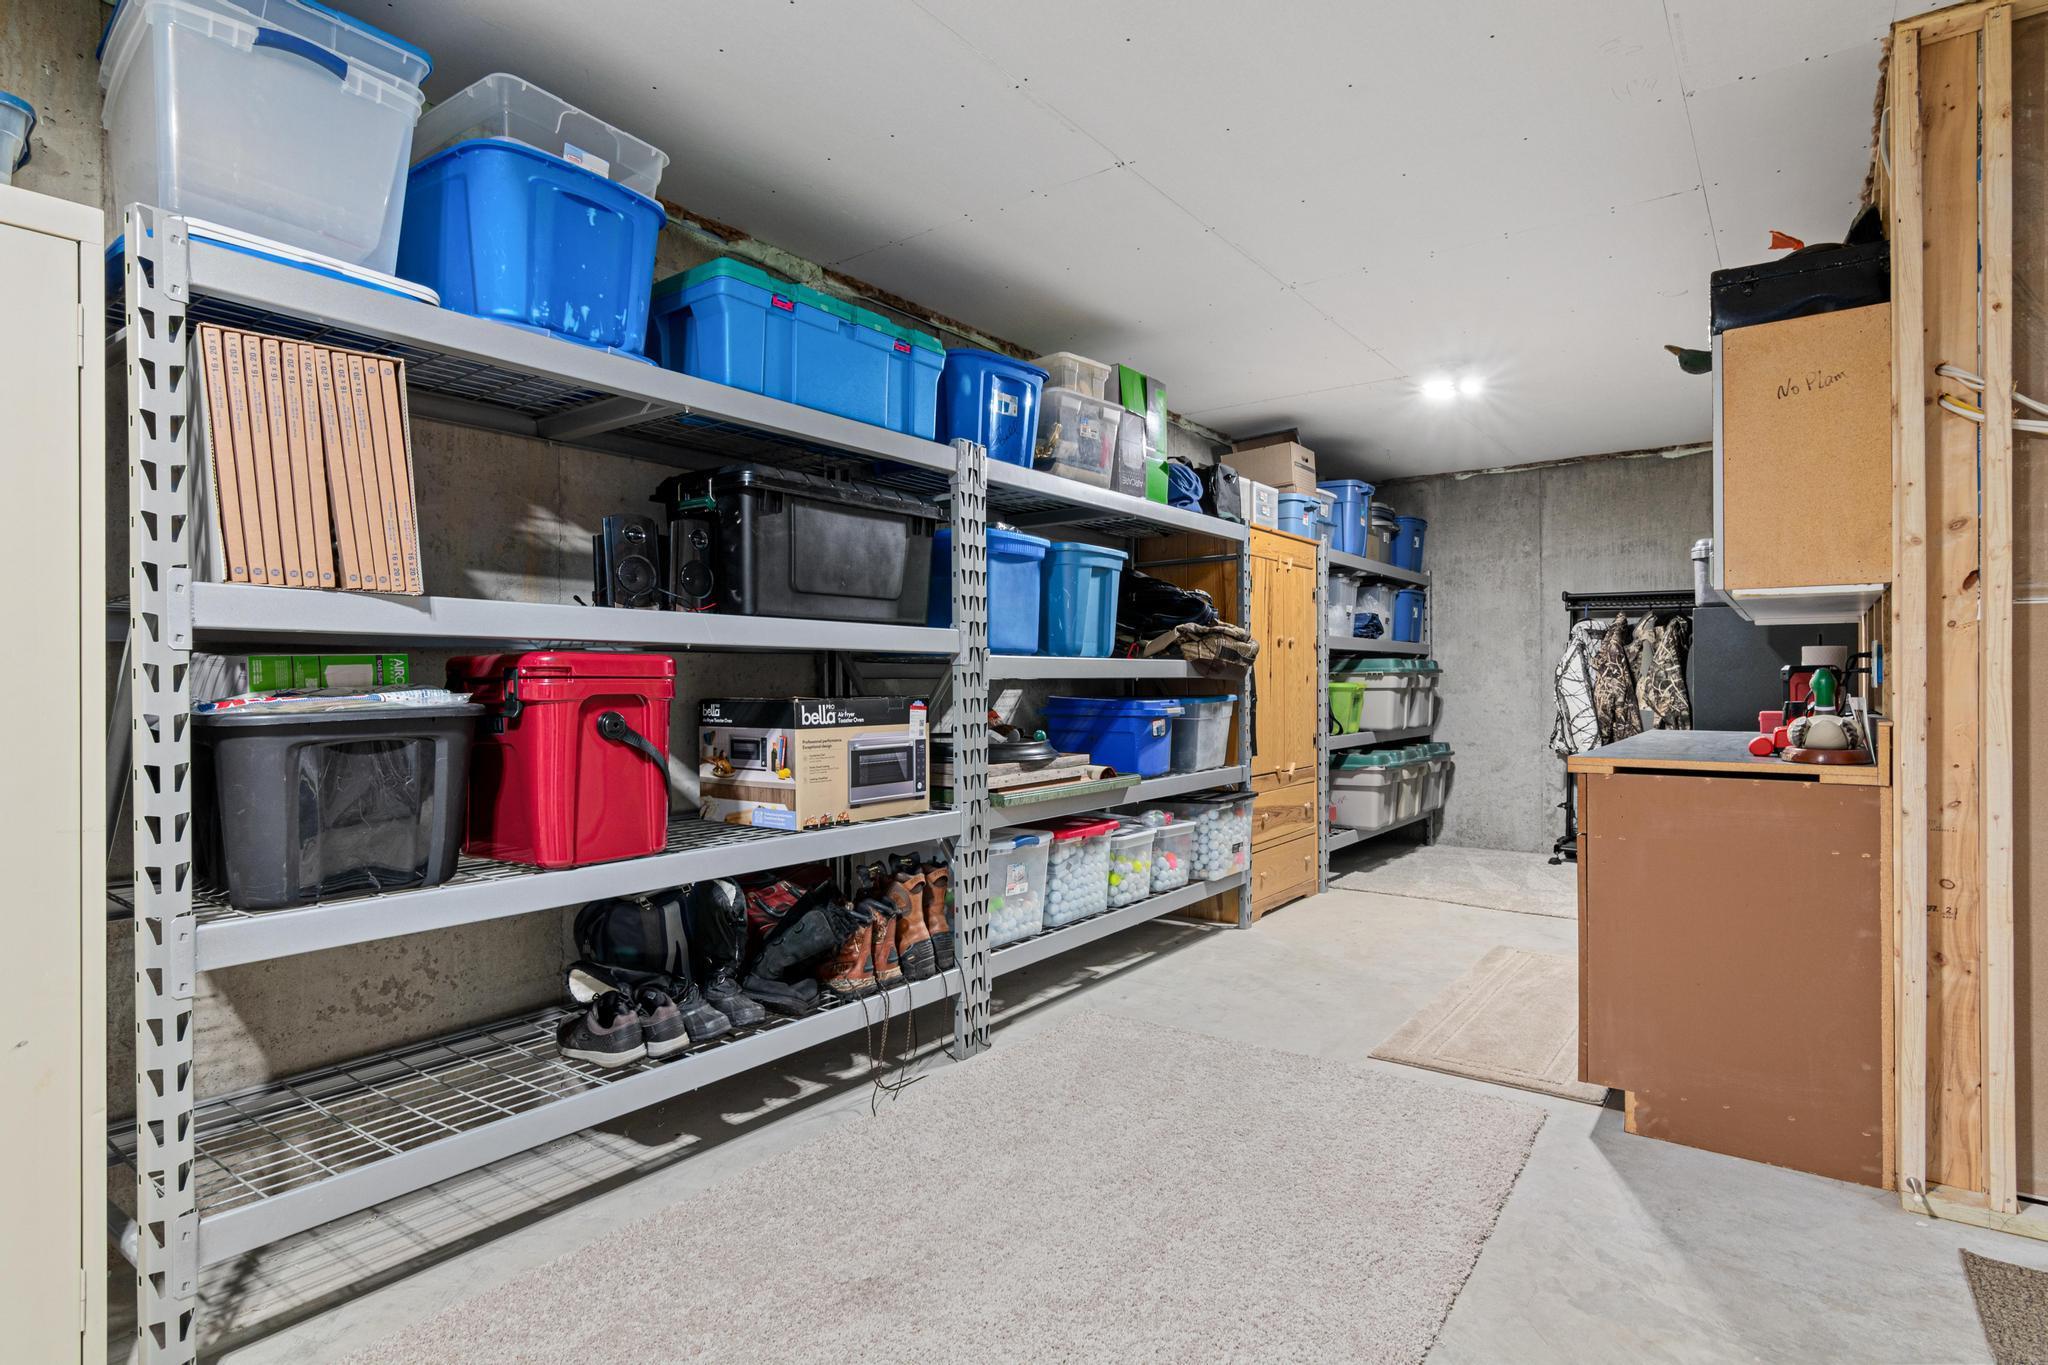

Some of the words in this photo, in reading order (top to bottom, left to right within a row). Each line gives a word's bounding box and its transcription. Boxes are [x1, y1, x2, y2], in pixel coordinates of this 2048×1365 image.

[210, 346, 217, 354] 20
[230, 350, 237, 358] 20
[250, 353, 257, 361] 20
[270, 356, 277, 365] 20
[212, 363, 219, 371] 16
[288, 359, 294, 368] 20
[232, 366, 239, 374] 16
[321, 367, 328, 375] 20
[338, 370, 345, 378] 20
[289, 376, 295, 384] 16
[354, 372, 360, 380] 20
[1777, 378, 1800, 400] No
[394, 568, 400, 576] 20
[410, 568, 416, 576] 20
[394, 658, 404, 685] AIRC
[702, 704, 720, 716] bella
[802, 704, 836, 725] bella
